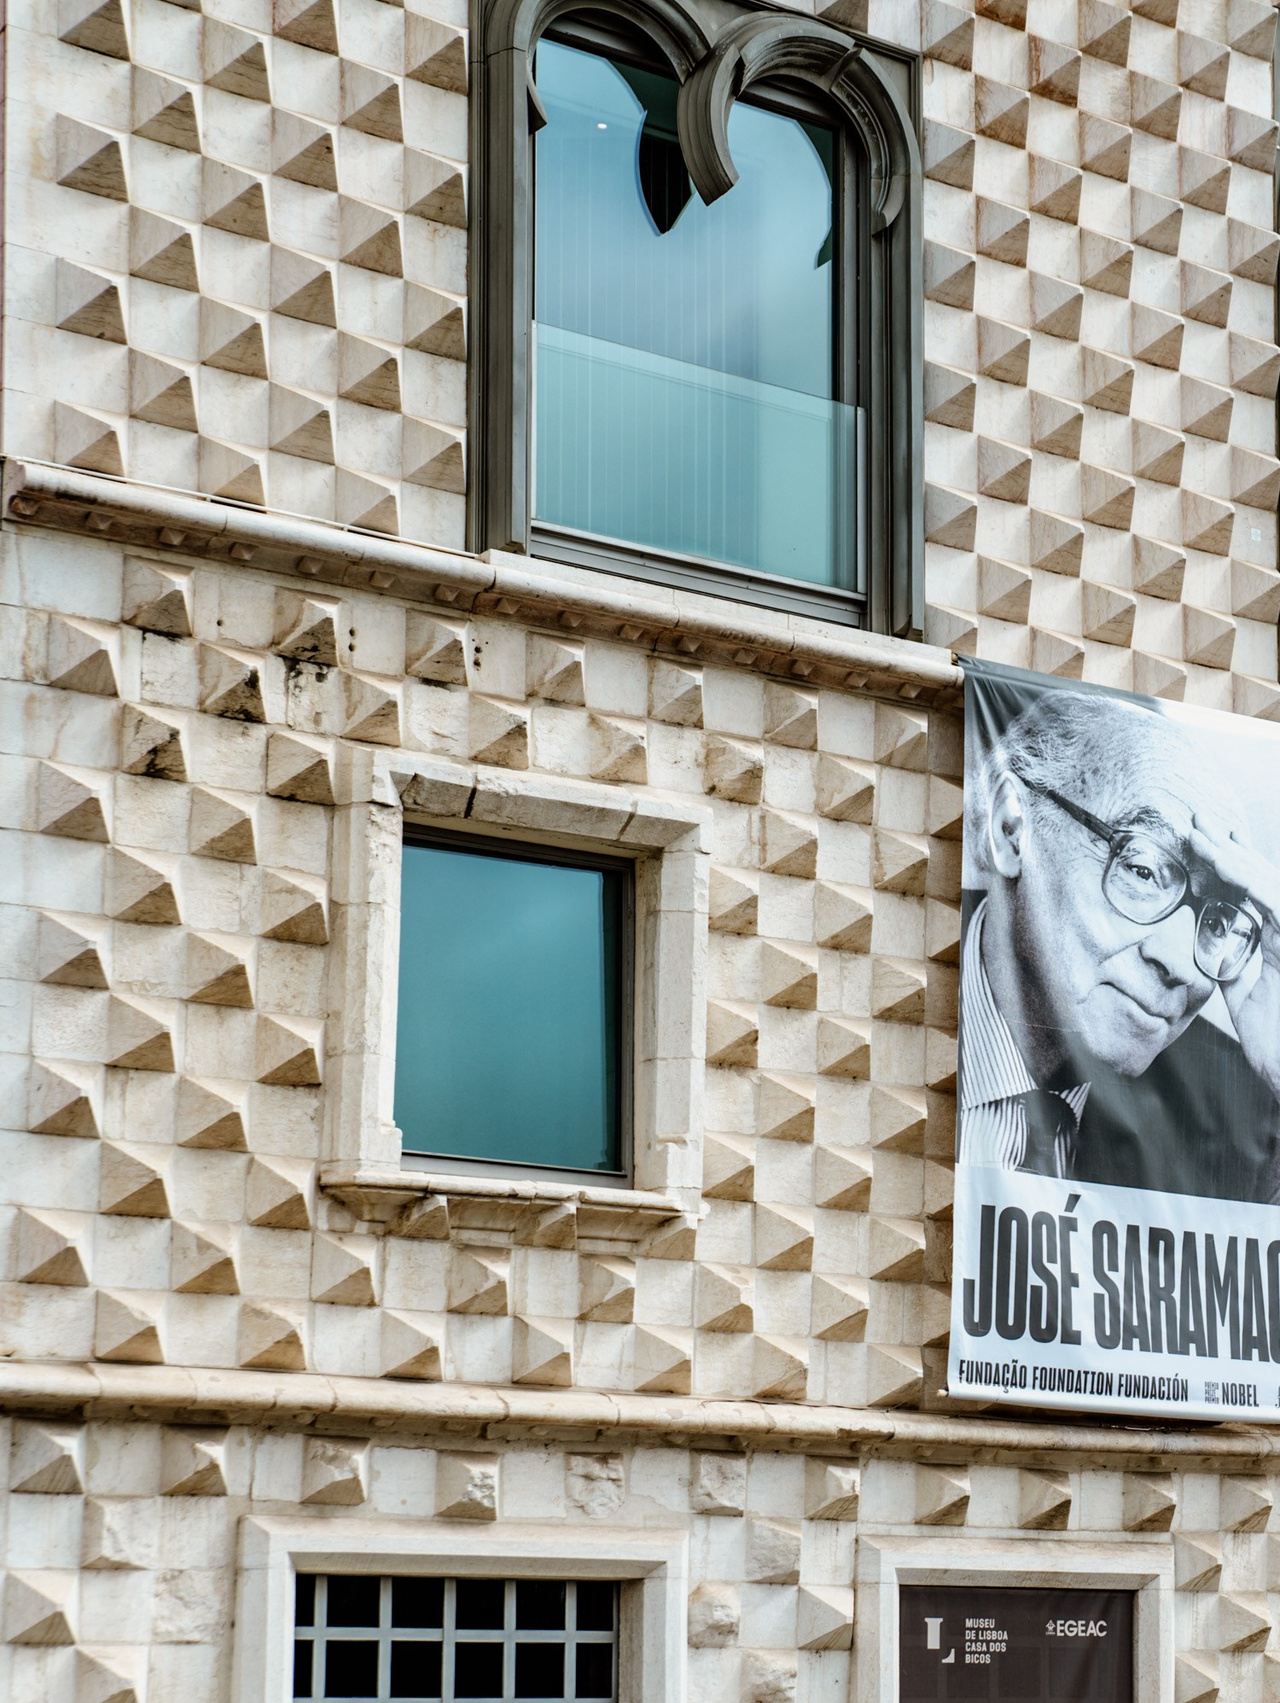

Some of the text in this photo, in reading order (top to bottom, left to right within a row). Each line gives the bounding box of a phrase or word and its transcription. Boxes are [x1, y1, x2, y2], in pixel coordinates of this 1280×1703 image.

[962, 1193, 1082, 1346] JOSÉ
[958, 1359, 1189, 1402] FUNDAÇÃO FOUNDATION FUNDACIÓN
[1221, 1381, 1260, 1408] NOBEL
[965, 1618, 995, 1628] MUSEU
[1056, 1619, 1107, 1637] EGEAC
[965, 1630, 1008, 1641] DE LISBOA
[965, 1641, 1007, 1652] CASA DOS
[965, 1653, 991, 1664] BICOS
